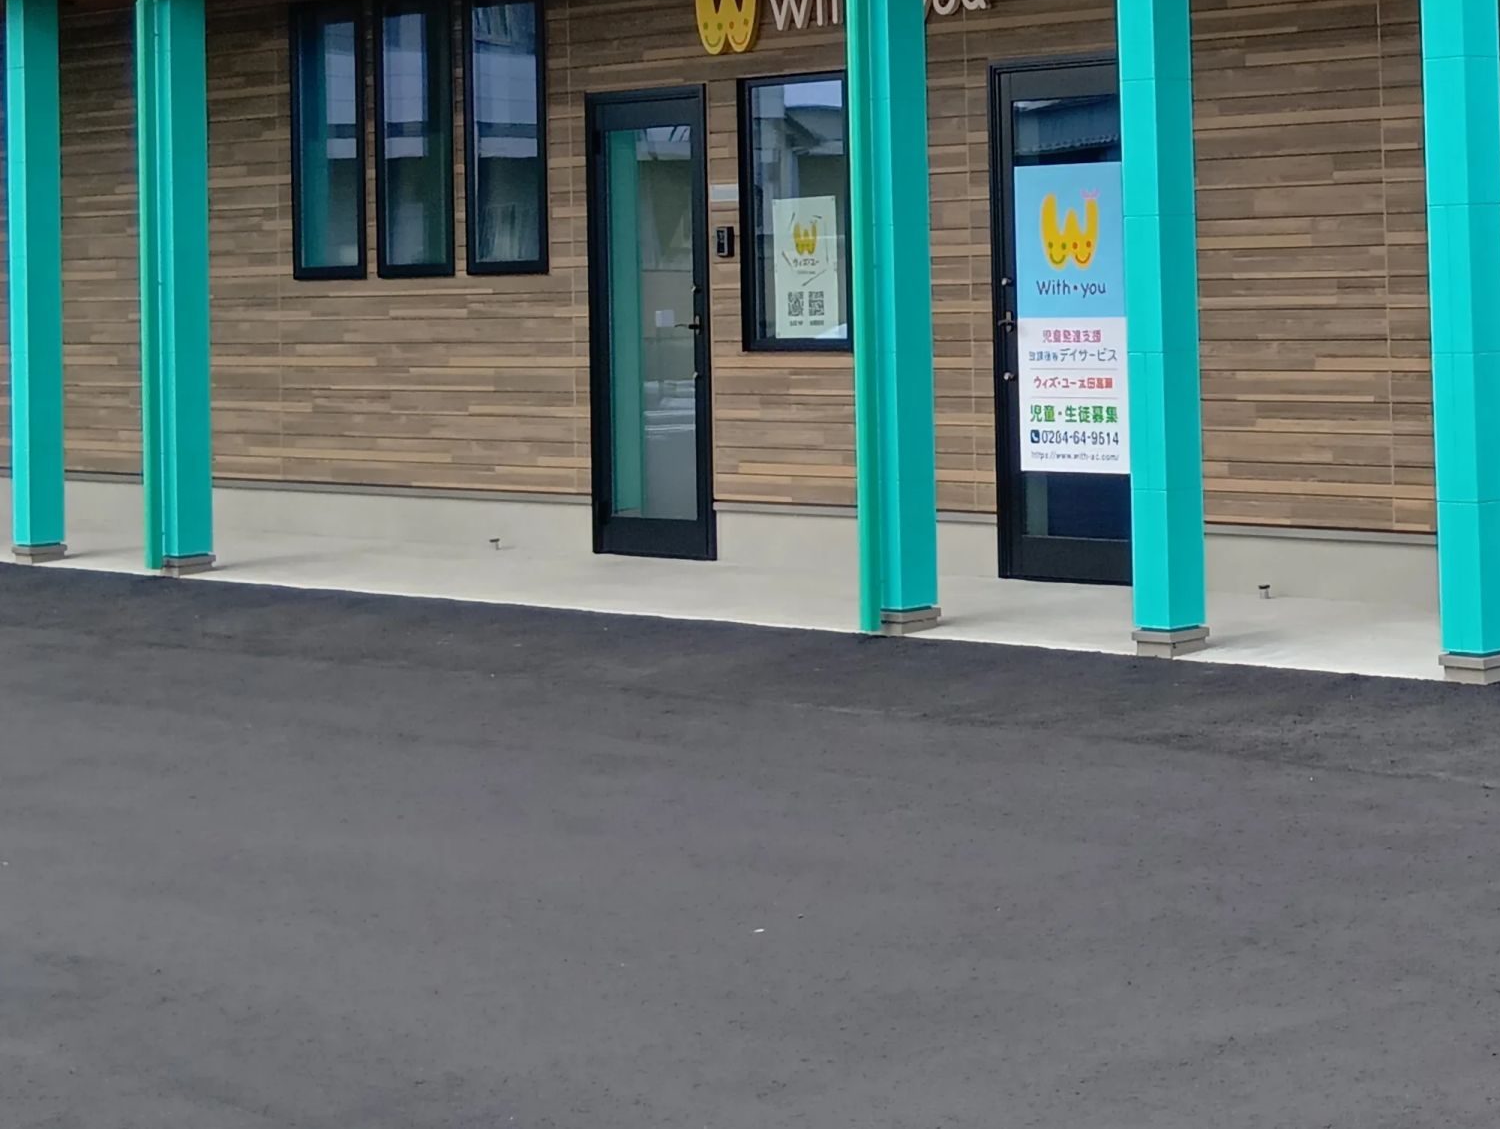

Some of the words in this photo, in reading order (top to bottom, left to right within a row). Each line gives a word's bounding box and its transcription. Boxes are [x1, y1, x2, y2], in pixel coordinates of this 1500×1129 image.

[1030, 405, 1118, 423] 児童・生徒募集
